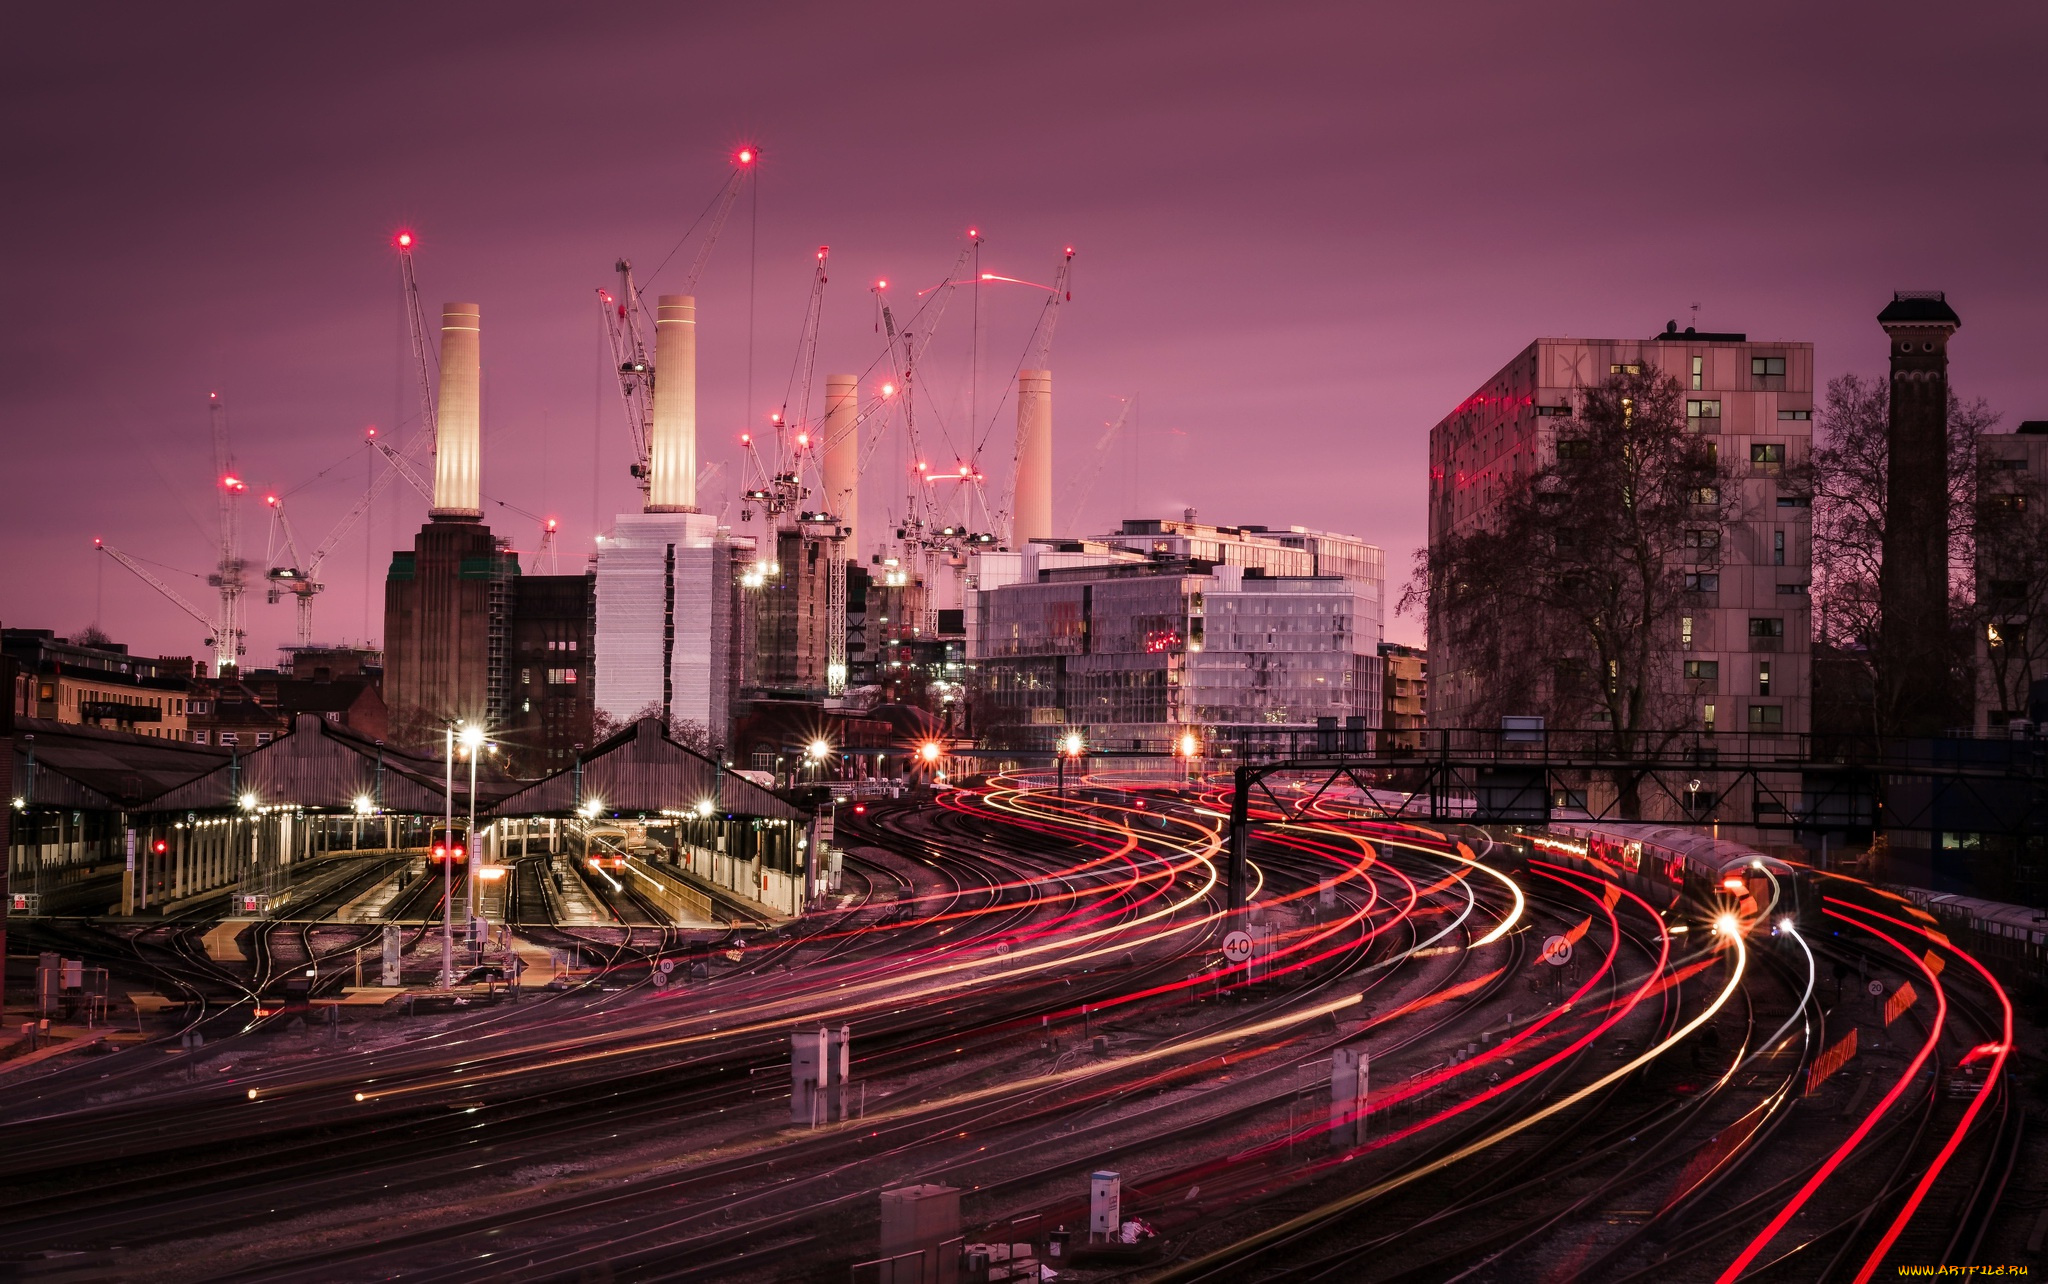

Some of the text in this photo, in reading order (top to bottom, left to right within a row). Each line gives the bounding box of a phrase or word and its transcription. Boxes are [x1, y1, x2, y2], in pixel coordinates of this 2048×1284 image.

[73, 812, 81, 822] 7
[187, 813, 195, 823] 6
[296, 810, 304, 820] 5
[638, 814, 646, 824] 2
[413, 816, 421, 826] 4
[532, 816, 539, 826] 3
[998, 945, 1008, 953] 40
[1226, 938, 1249, 954] 40
[1546, 943, 1568, 958] 40
[663, 961, 671, 969] 10
[656, 975, 664, 983] 10
[1871, 983, 1882, 992] 20
